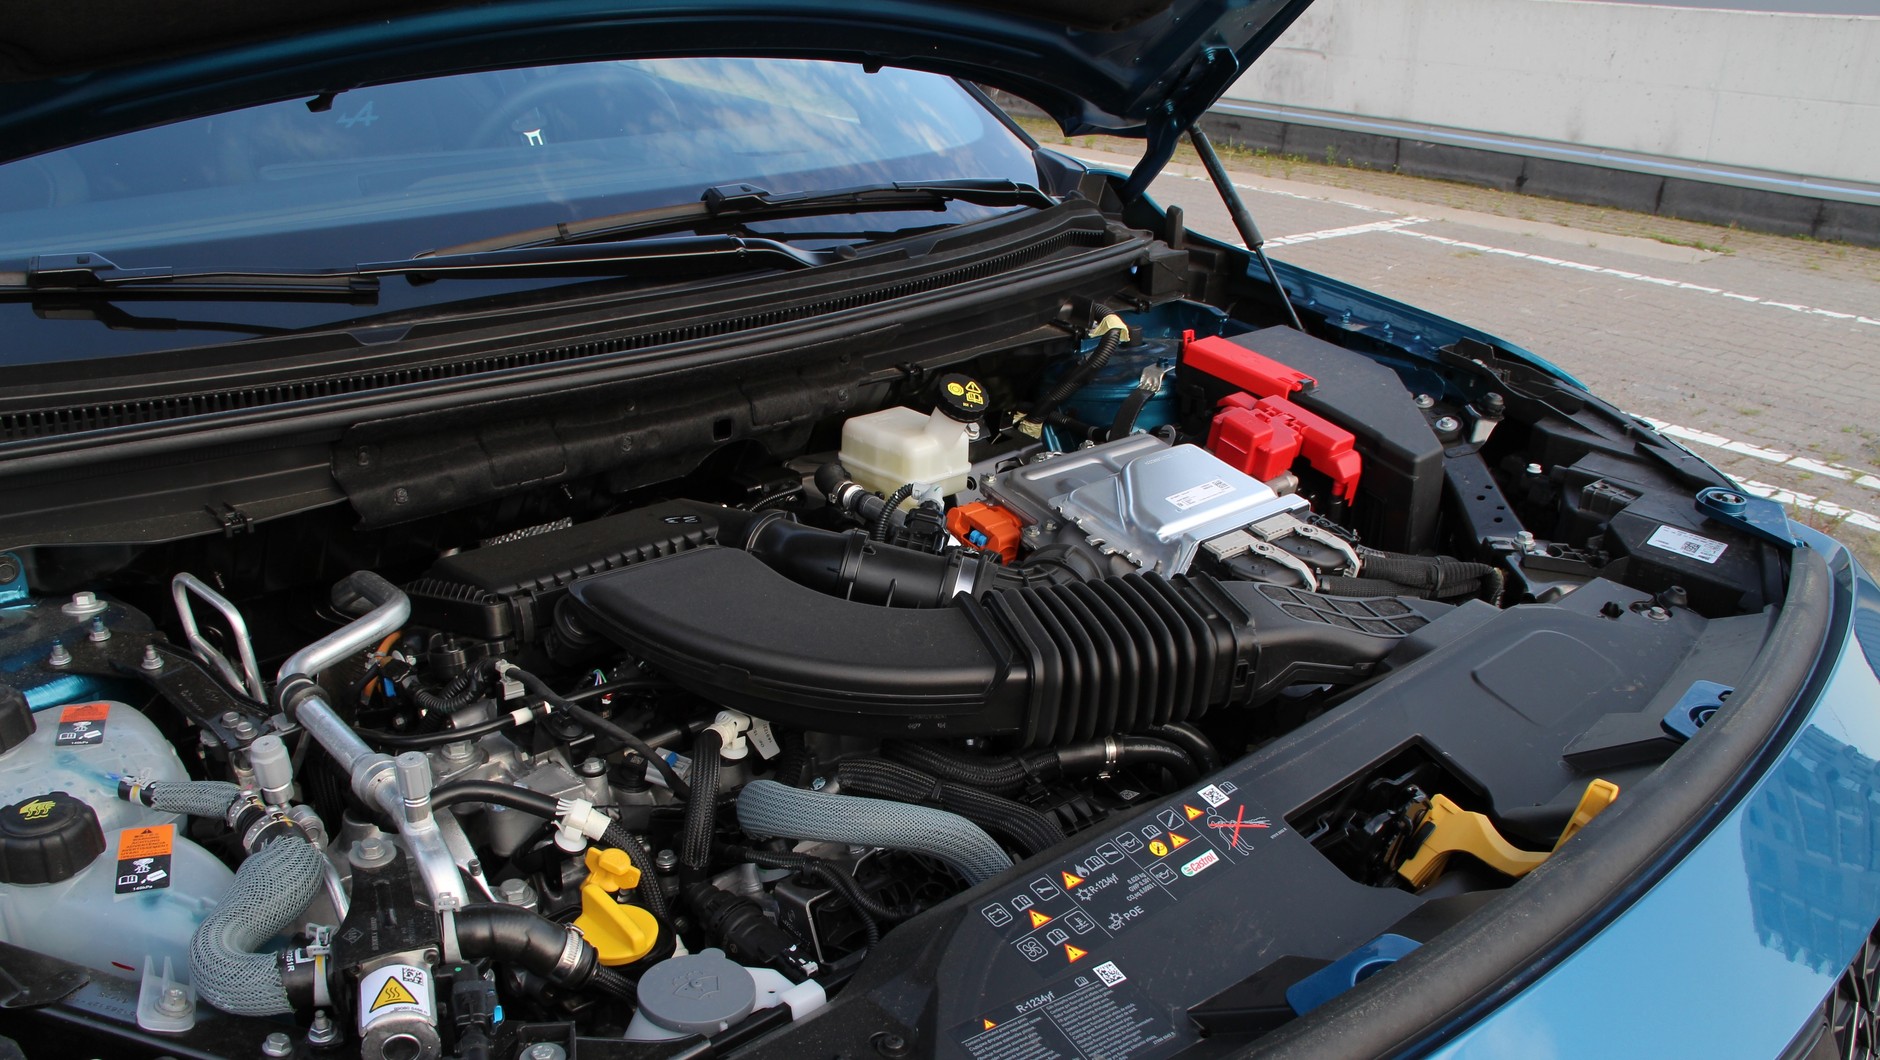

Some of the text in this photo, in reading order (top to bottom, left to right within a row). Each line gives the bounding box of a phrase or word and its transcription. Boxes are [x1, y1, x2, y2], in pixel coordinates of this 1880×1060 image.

[1190, 852, 1217, 872] Castrol
[1088, 873, 1119, 894] R-1234yf
[1123, 905, 1144, 921] POE
[1015, 991, 1055, 1014] R-1234yf
